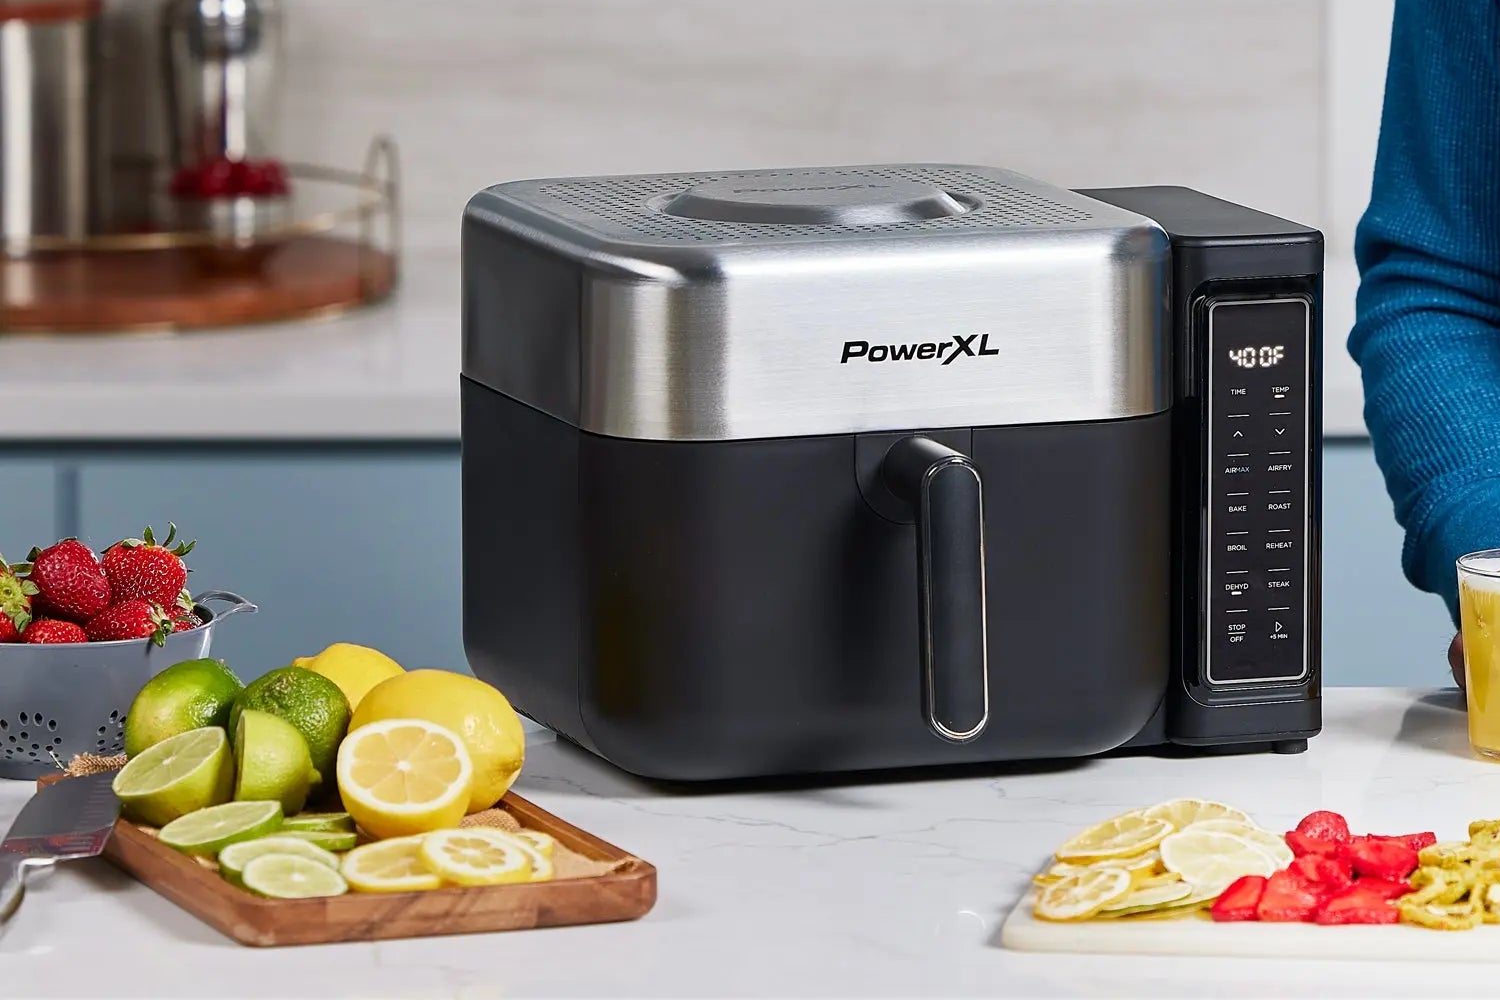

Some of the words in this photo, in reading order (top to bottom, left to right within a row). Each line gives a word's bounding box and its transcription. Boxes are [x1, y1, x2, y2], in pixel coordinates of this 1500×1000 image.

[840, 333, 1000, 366] PowerXL
[1230, 388, 1247, 396] TIME
[1271, 386, 1290, 394] TEMP
[1224, 466, 1250, 474] AIRMAX
[1267, 464, 1293, 472] AIRFRY
[1228, 505, 1247, 513] BAKE
[1267, 502, 1292, 511] ROAST
[1226, 544, 1248, 552] BROIL
[1265, 541, 1293, 550] REHEAT
[1225, 582, 1249, 591] DEHYD
[1267, 580, 1290, 588] STEAK
[1227, 623, 1246, 631] STOP
[1229, 635, 1244, 643] OFF
